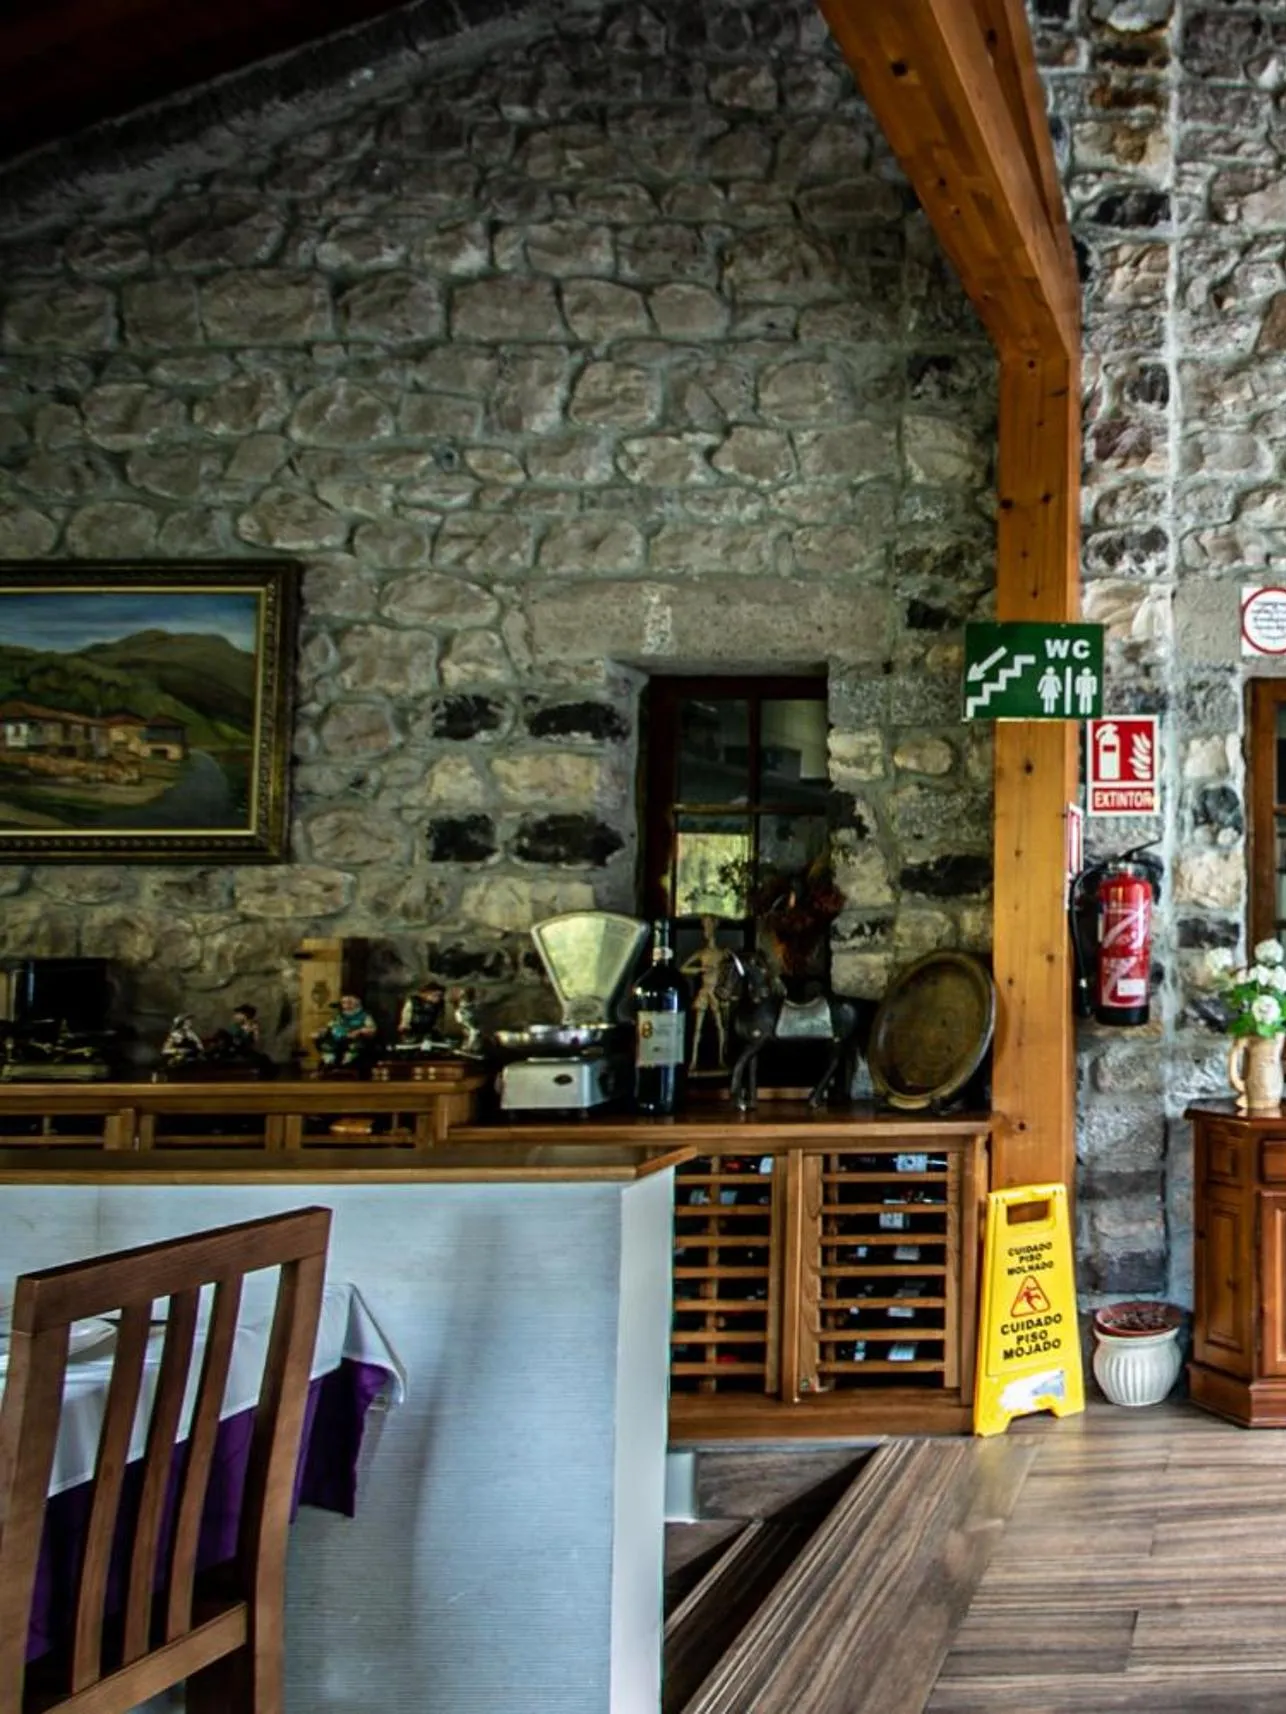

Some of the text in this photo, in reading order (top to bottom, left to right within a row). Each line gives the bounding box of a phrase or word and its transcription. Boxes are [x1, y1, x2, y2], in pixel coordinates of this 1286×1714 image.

[1045, 639, 1090, 659] WC
[1095, 790, 1153, 808] EXTINTOR
[1008, 1242, 1053, 1256] CUIDADO
[1019, 1253, 1042, 1265] PISO
[1000, 1313, 1062, 1336] CUIDADO
[1016, 1329, 1048, 1345] PISO
[1003, 1338, 1061, 1361] MOJADO
